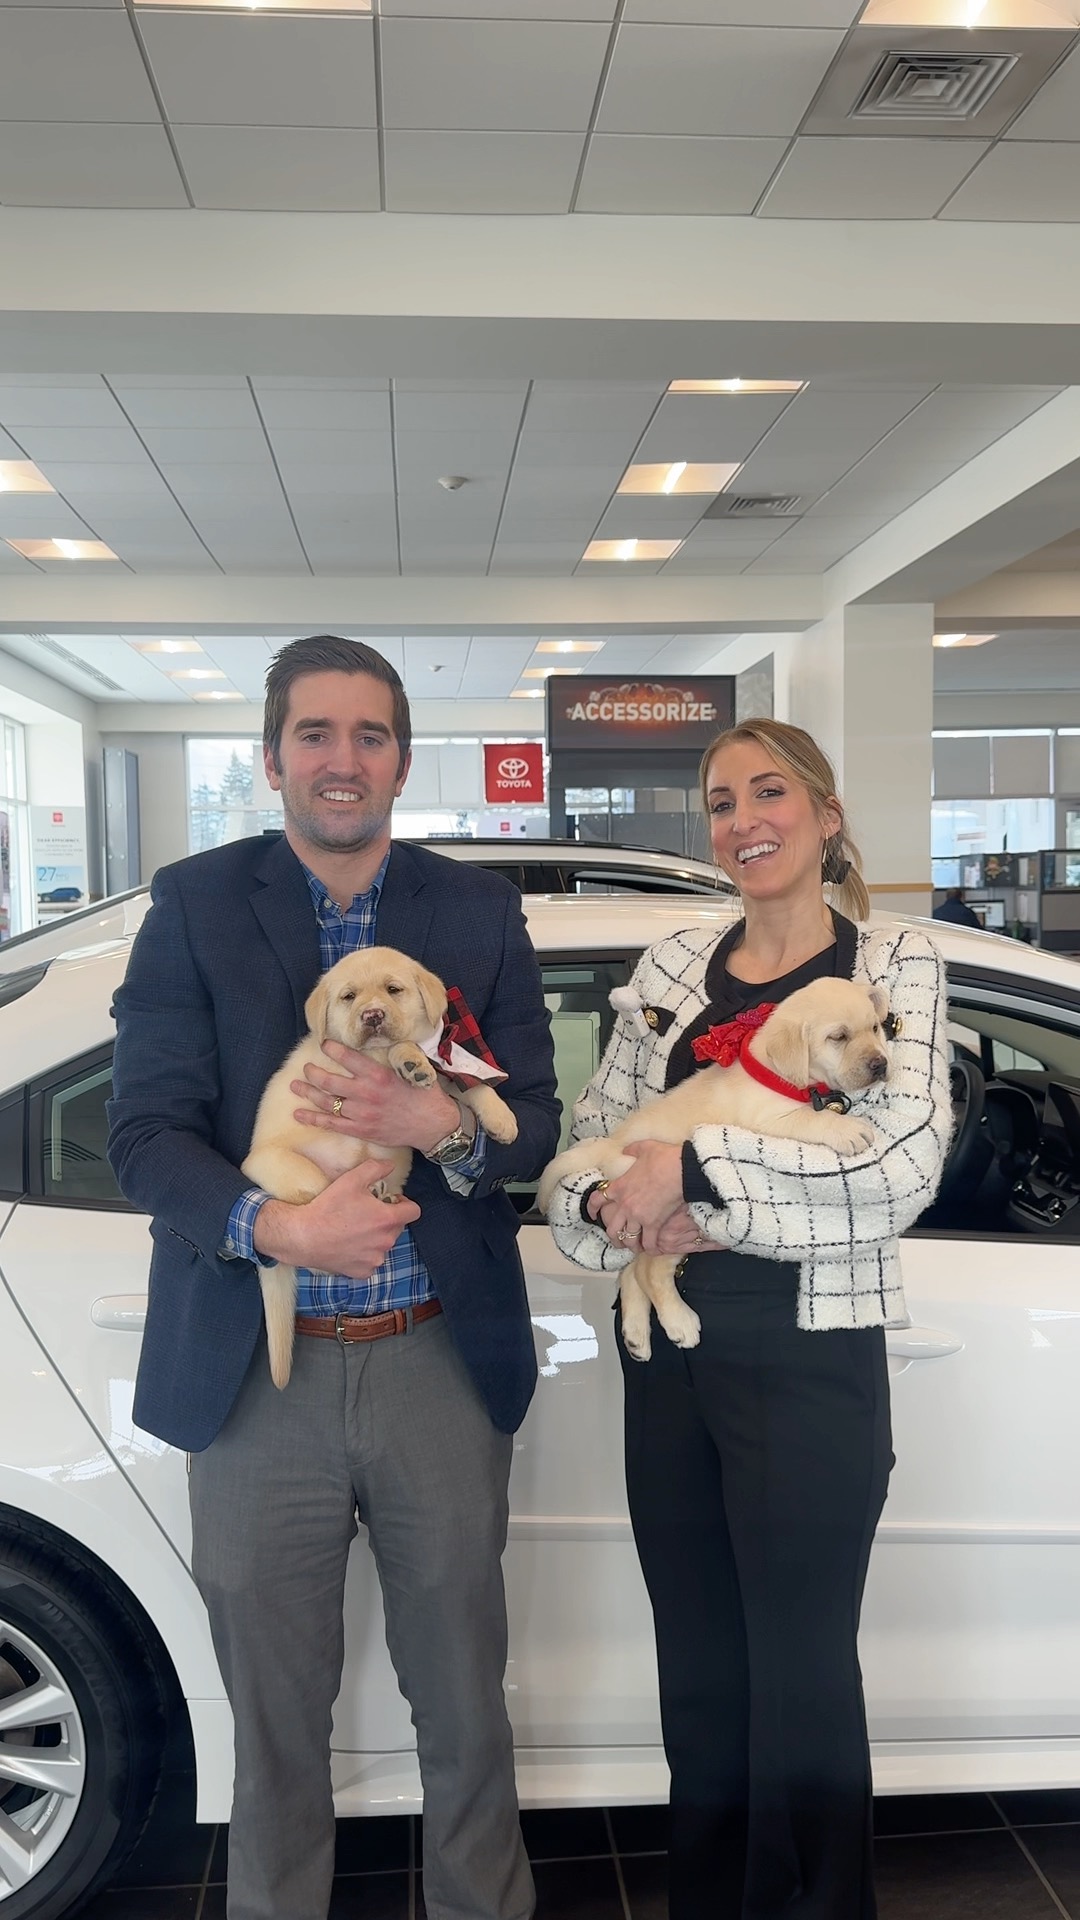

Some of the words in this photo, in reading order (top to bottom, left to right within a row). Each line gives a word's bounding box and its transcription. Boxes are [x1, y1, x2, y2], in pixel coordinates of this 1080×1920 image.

[571, 702, 713, 721] ACCESSORIZE
[496, 780, 532, 788] TOYOTA
[39, 866, 56, 881] 27
